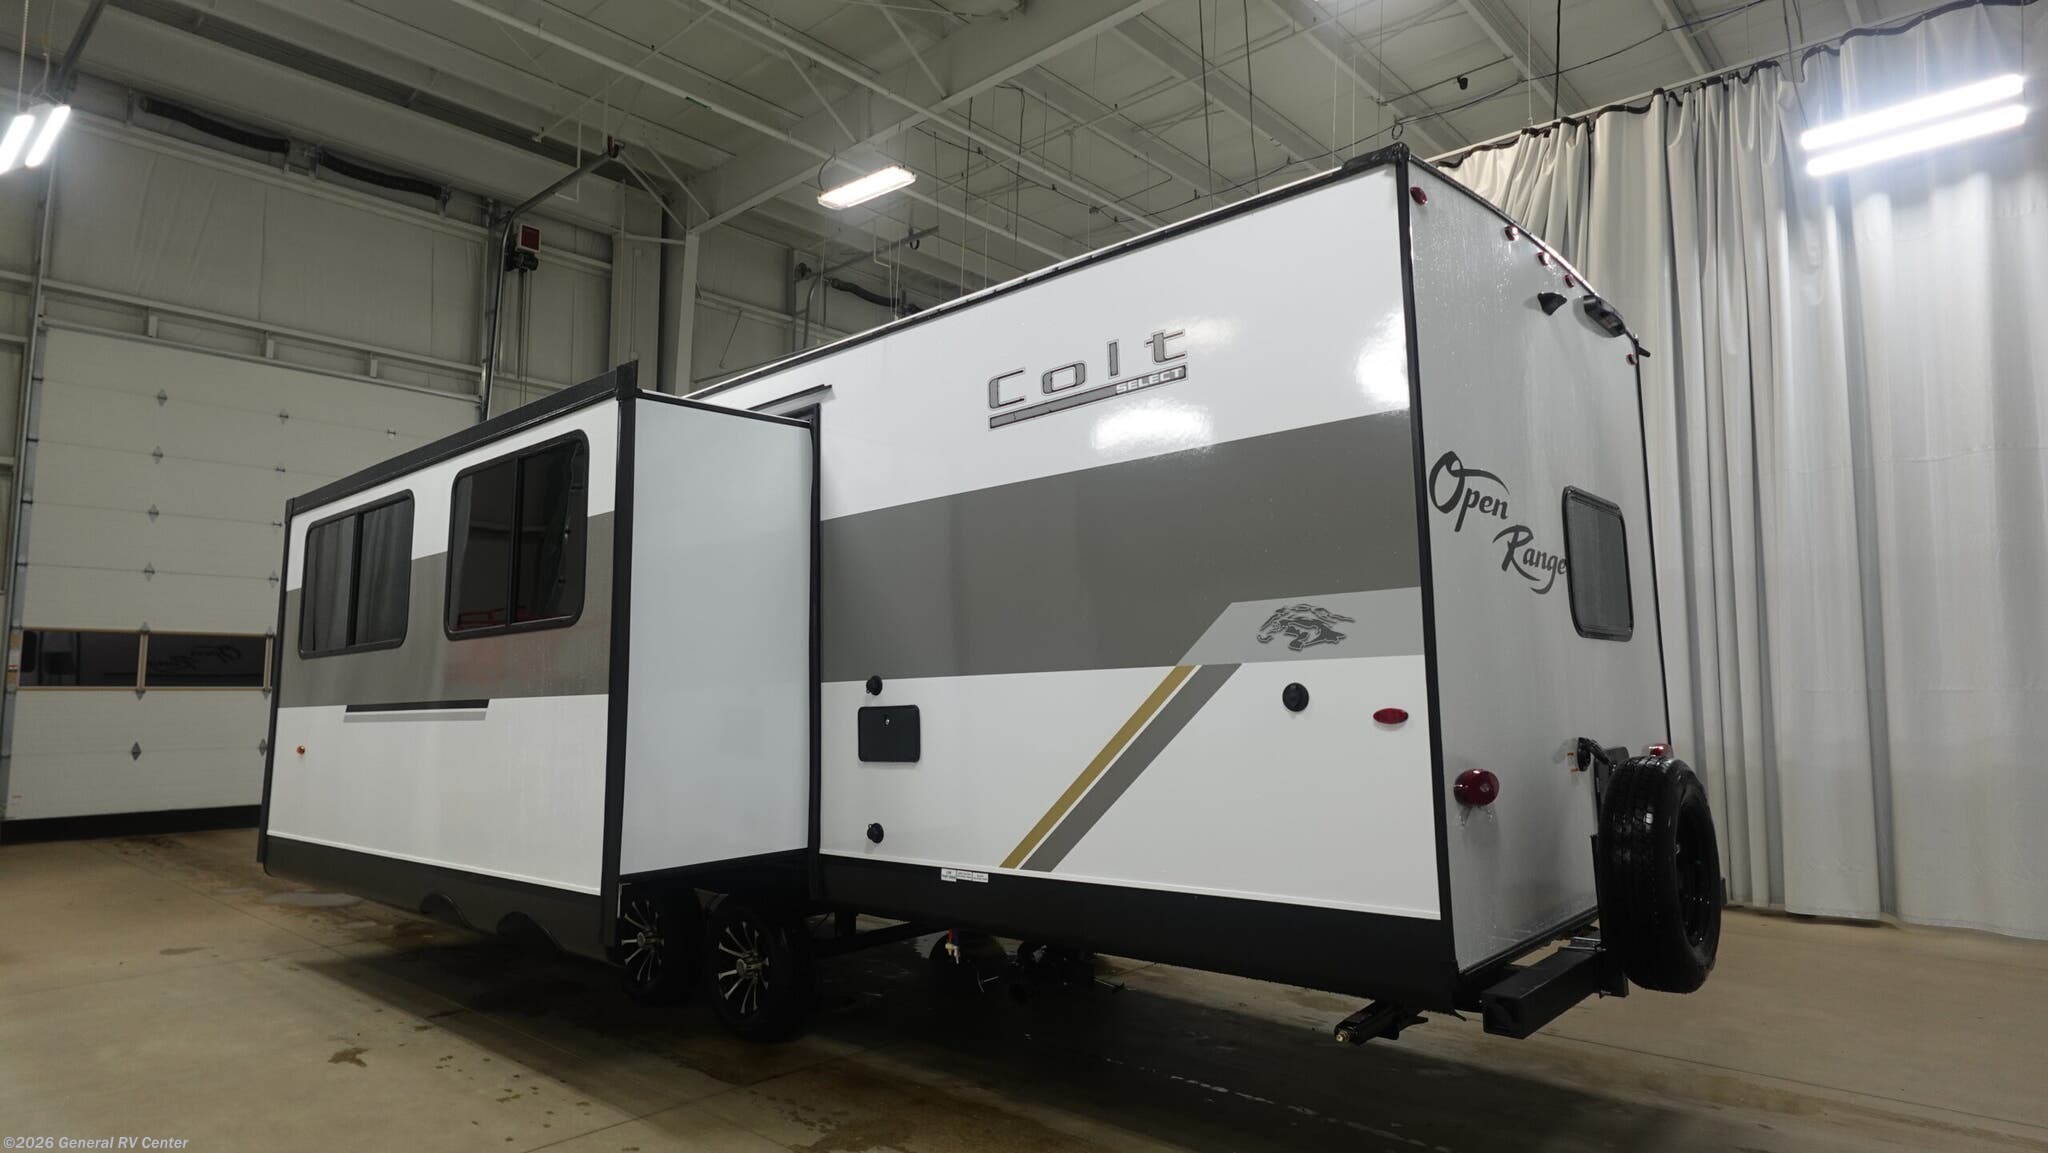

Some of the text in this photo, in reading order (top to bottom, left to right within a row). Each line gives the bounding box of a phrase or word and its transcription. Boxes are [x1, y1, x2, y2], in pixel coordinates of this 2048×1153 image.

[988, 331, 1187, 409] Colt
[1115, 367, 1184, 395] SELECT
[1429, 451, 1510, 533] Open
[1492, 524, 1567, 595] Range
